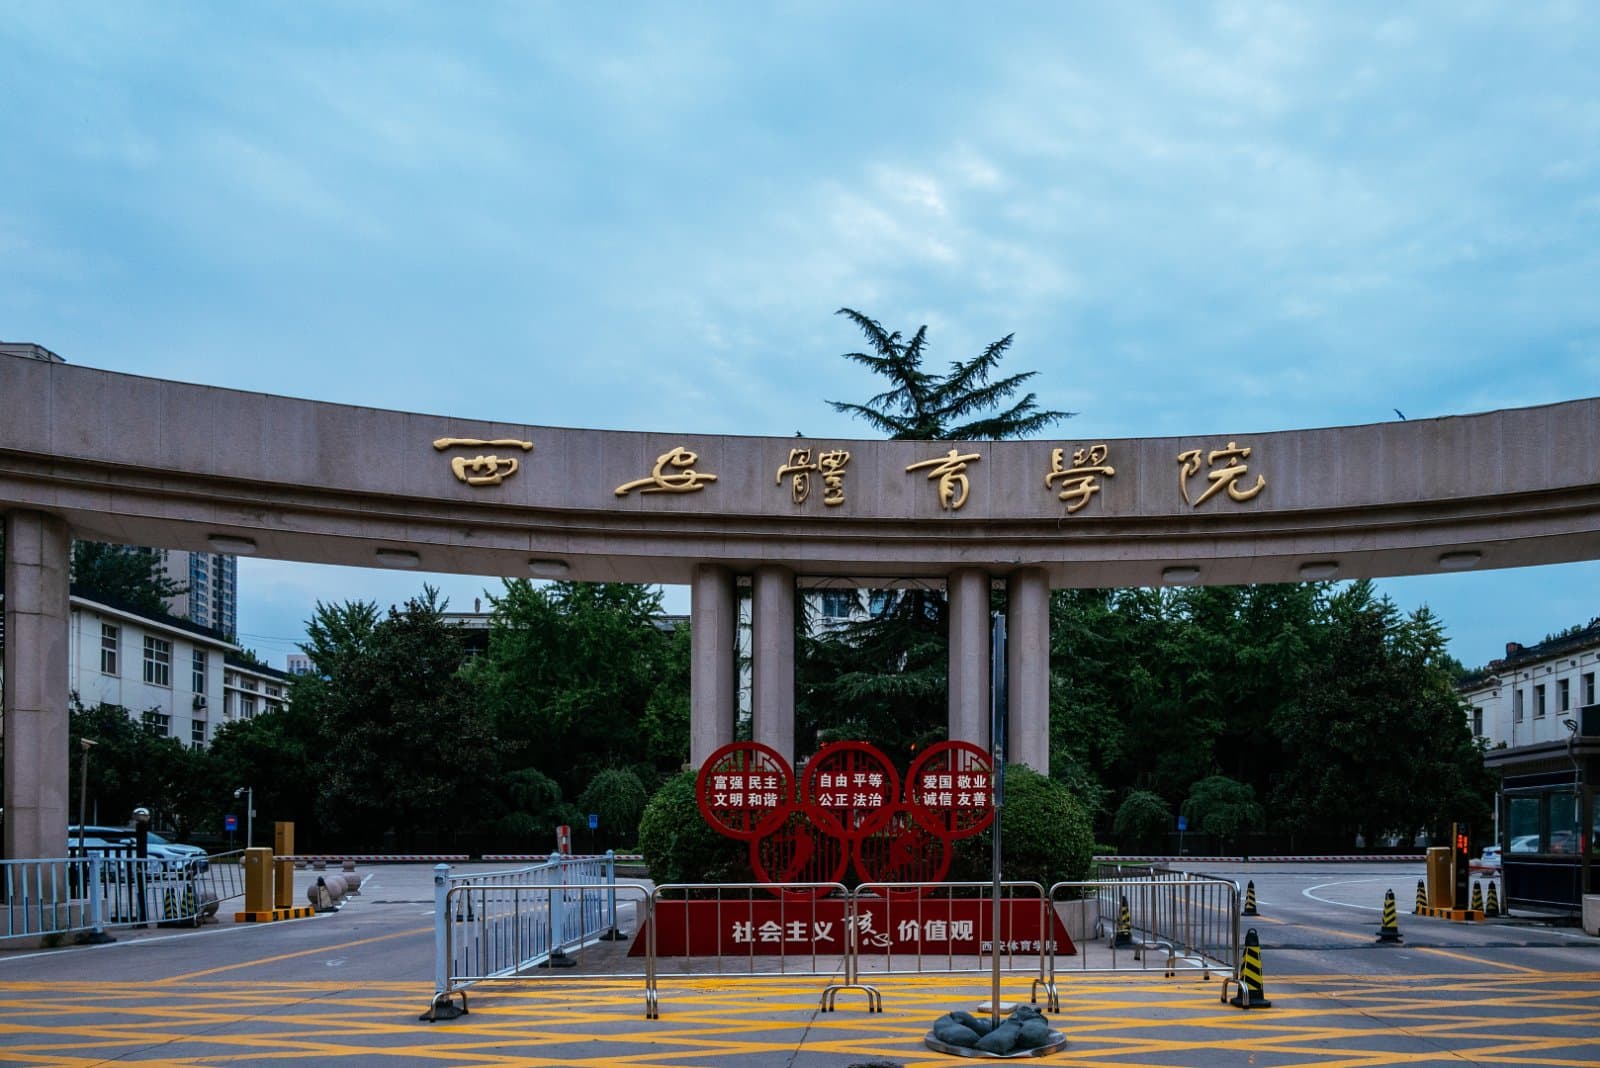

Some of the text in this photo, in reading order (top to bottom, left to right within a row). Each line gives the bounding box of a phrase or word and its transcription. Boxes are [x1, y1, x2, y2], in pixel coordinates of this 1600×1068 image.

[713, 775, 778, 790] 富强 民主
[820, 773, 882, 788] 自由 平等
[923, 774, 987, 789] 爱国 敬业
[713, 792, 778, 807] 文明 和谐
[818, 792, 882, 807] 公正 法治
[922, 791, 986, 806] 诚信 友善
